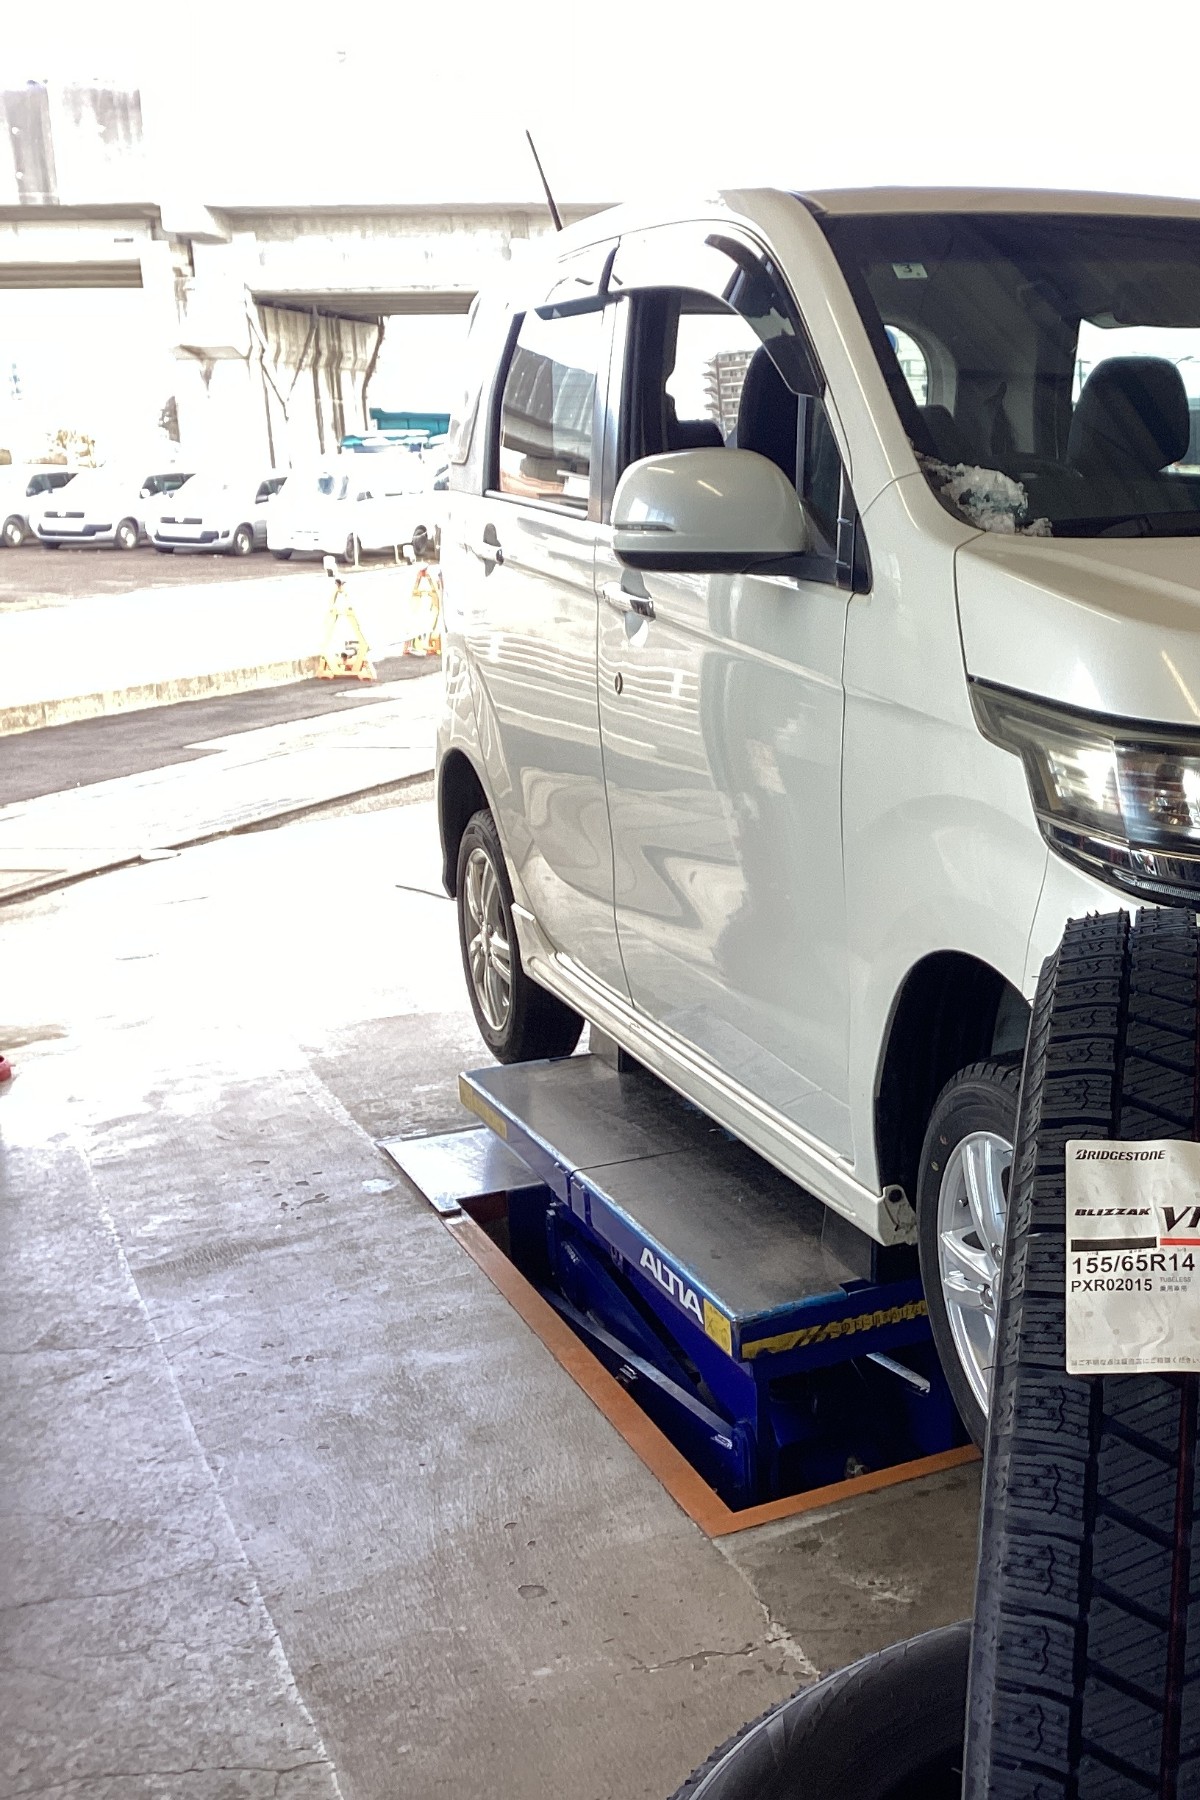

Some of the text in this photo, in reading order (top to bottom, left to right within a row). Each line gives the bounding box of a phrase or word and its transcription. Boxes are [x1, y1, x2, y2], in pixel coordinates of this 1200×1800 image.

[1075, 1149, 1166, 1161] BRIDGESTONE
[1075, 1207, 1151, 1216] BLIZZAK
[1072, 1253, 1195, 1274] 155/65R14
[640, 1247, 704, 1325] ALTIA
[1071, 1278, 1152, 1292] PXR02015
